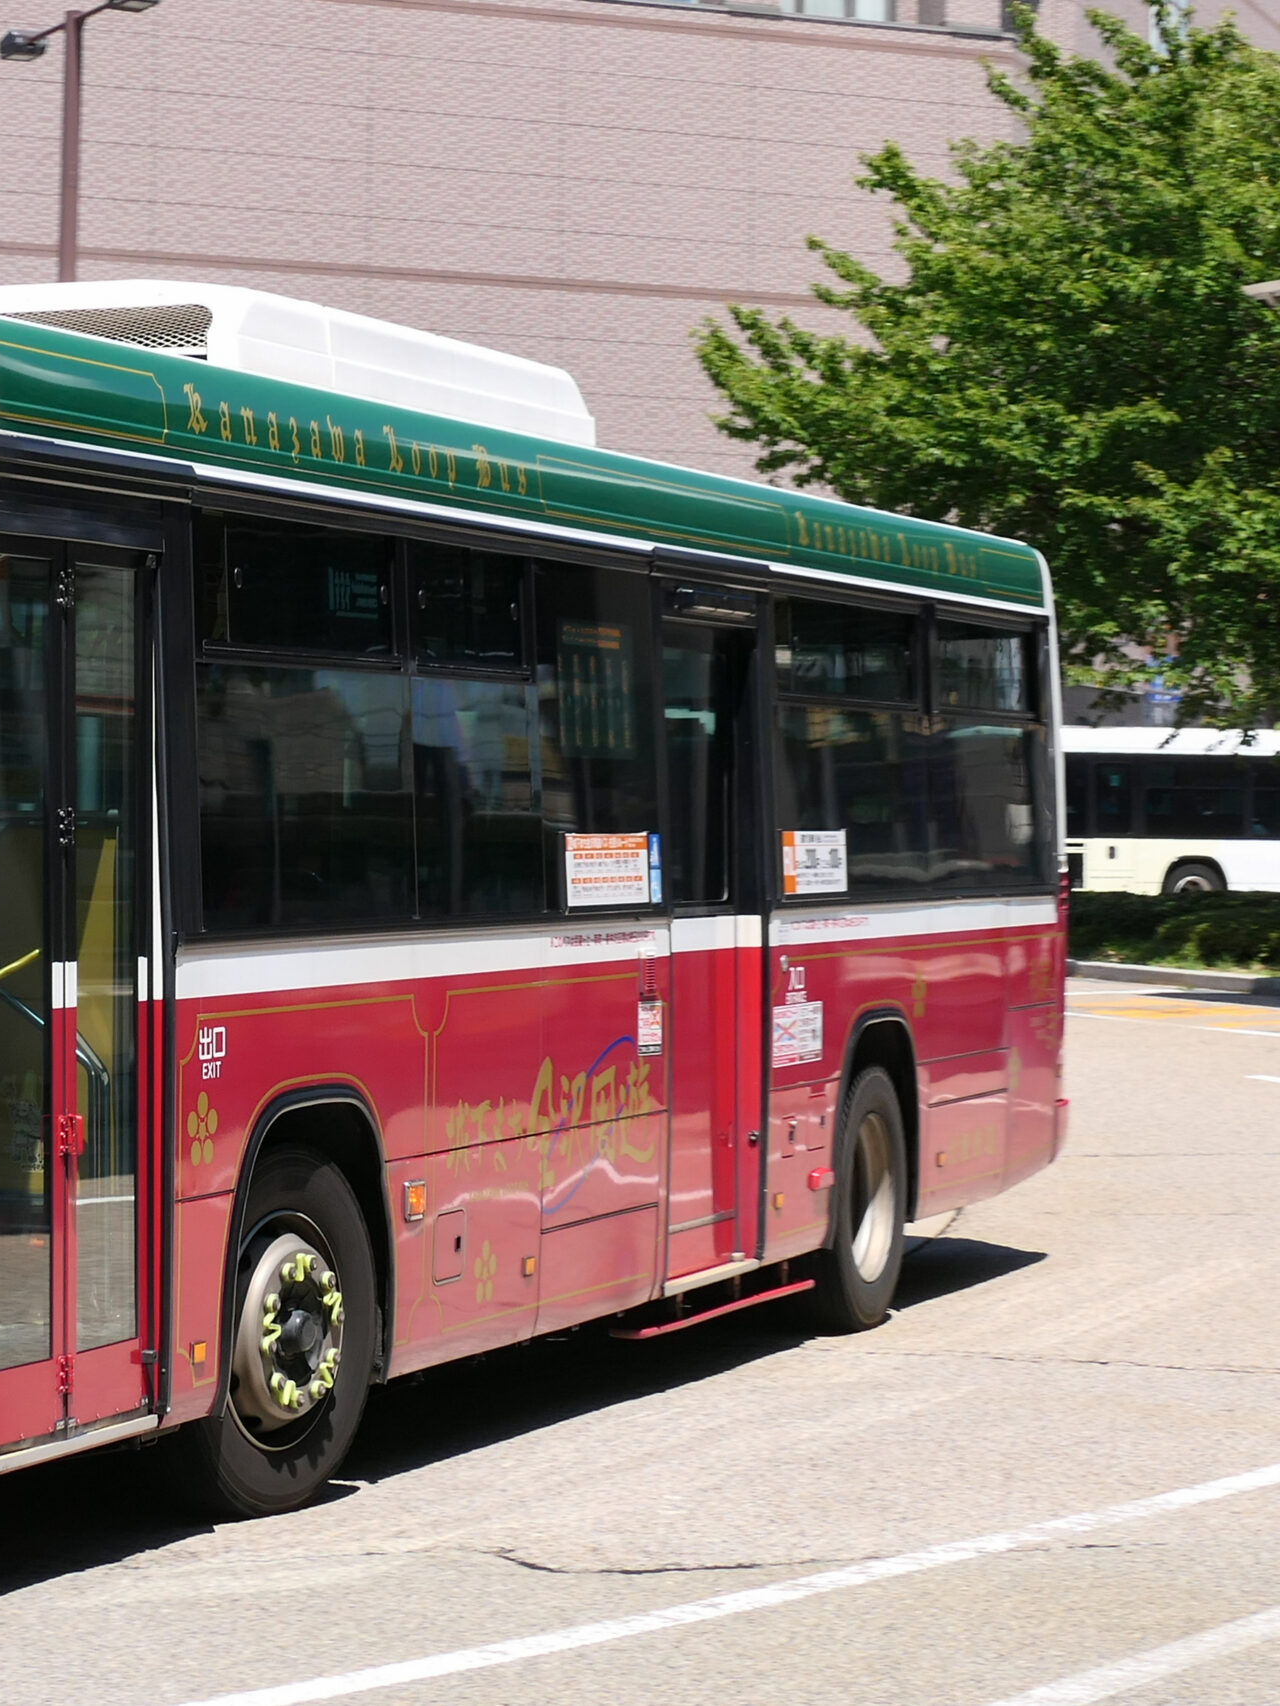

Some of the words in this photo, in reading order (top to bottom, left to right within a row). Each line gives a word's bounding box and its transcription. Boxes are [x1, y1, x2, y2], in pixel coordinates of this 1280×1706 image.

[183, 383, 367, 468] Kanazawa
[383, 425, 457, 490] Loop
[472, 444, 527, 496] Bus
[199, 1026, 226, 1060] 出口
[202, 1061, 222, 1080] EXIT
